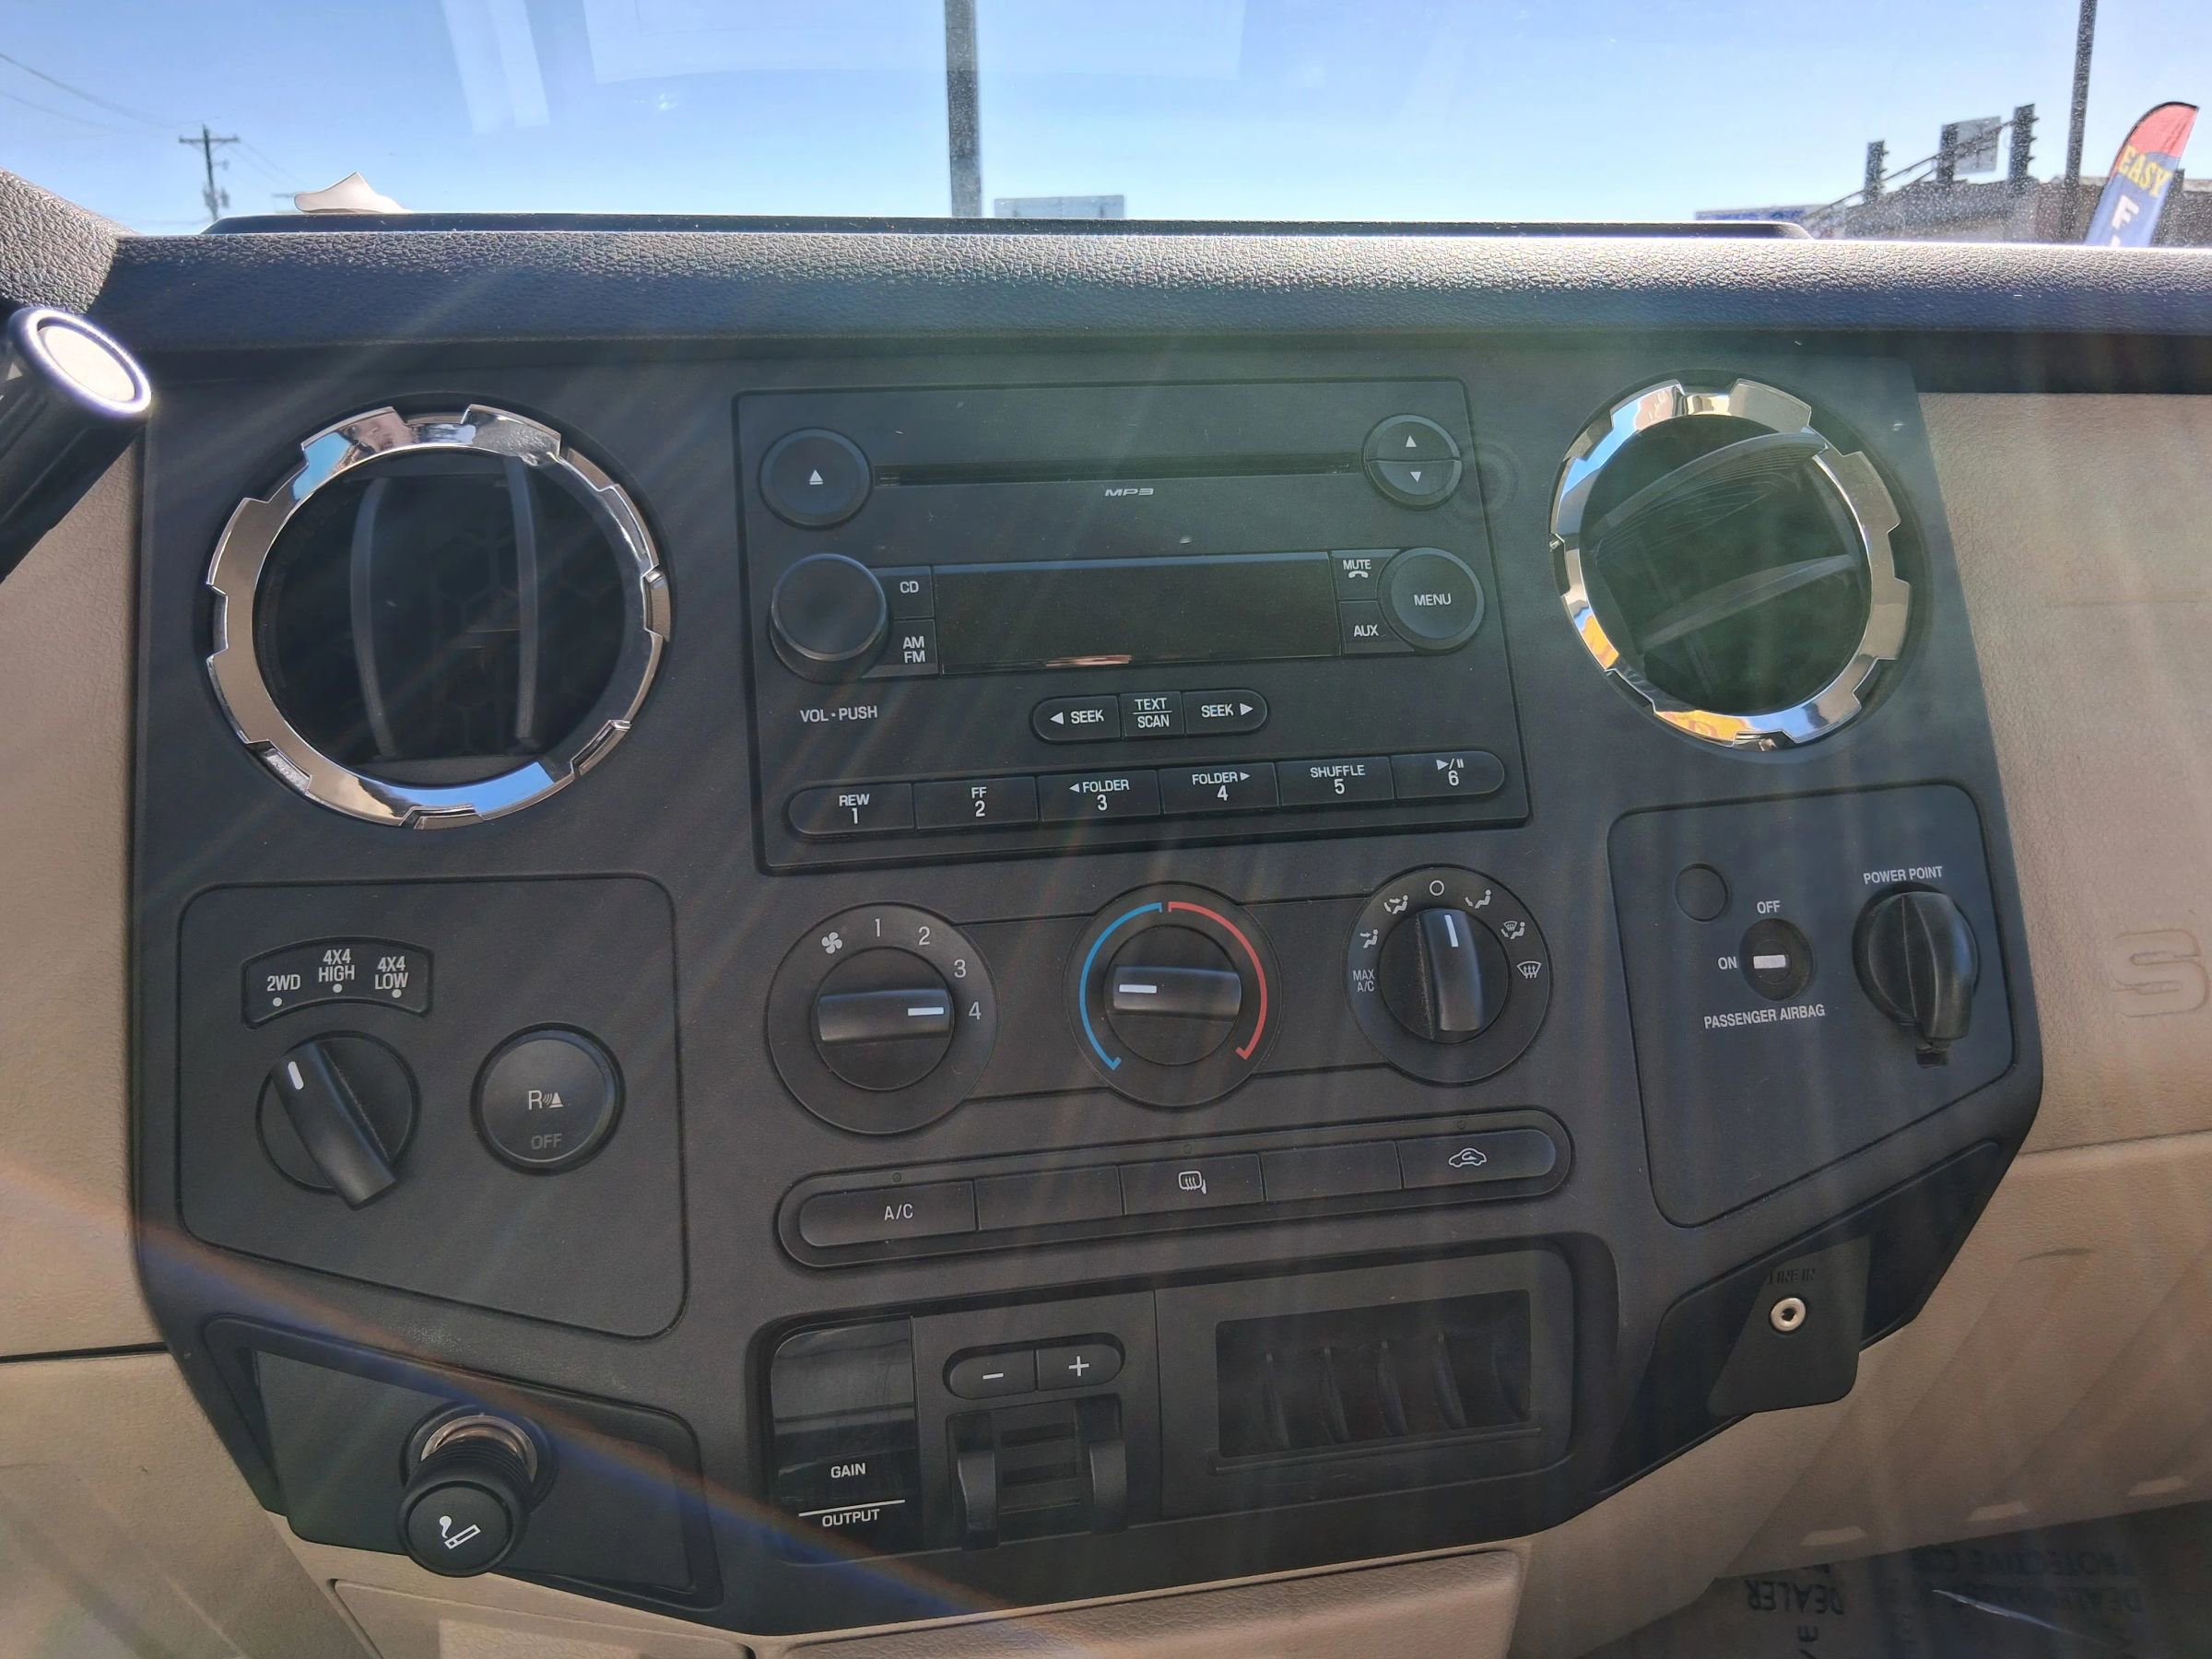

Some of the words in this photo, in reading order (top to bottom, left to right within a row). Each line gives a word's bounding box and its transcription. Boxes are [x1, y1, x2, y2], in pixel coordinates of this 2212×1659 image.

[2118, 145, 2173, 198] EASY
[1104, 488, 1154, 497] MP3
[1342, 559, 1372, 571] MUTE
[900, 581, 920, 594] CD
[1413, 593, 1452, 606] MENU
[1353, 624, 1380, 637] AUX
[902, 635, 925, 650] AM
[903, 650, 926, 664] FM
[1134, 698, 1168, 712] TEXT
[1201, 703, 1234, 718] SEEK
[799, 709, 830, 723] VOL
[838, 705, 878, 721] PUSH
[1070, 709, 1104, 724] SEEK
[1136, 714, 1171, 729] SCAN
[1192, 771, 1239, 785] FOLDER
[1310, 764, 1366, 779] SHUFFLE
[1448, 768, 1460, 786] 6
[971, 786, 987, 799] FF
[1082, 779, 1130, 794] FOLDER
[1217, 784, 1229, 801] 4
[1334, 778, 1346, 794] 5
[839, 794, 870, 806] REW
[1097, 794, 1108, 811] 3
[852, 807, 858, 825] 1
[974, 800, 985, 818] 2
[1863, 870, 1907, 885] POWER
[1908, 865, 1943, 880] POINT
[1757, 900, 1781, 914] OFF
[875, 918, 880, 937] 1
[918, 925, 931, 946] 2
[323, 947, 352, 965] 4X4
[377, 955, 406, 972] 4X4
[1717, 956, 1738, 971] ON
[318, 964, 356, 982] HIGH
[954, 959, 967, 978] 3
[1352, 970, 1375, 982] MAX
[266, 973, 301, 992] 2WD
[373, 972, 409, 990] LOW
[1357, 980, 1375, 993] A/C
[968, 1001, 982, 1020] 4
[1703, 1010, 1778, 1030] PASSENGER
[1780, 1004, 1826, 1021] AIRBAG
[530, 1133, 563, 1151] OFF
[884, 1203, 913, 1221] A/C
[830, 1462, 866, 1478] GAIN
[822, 1508, 880, 1527] OUTPUT
[1745, 1579, 1843, 1615] DEALER
